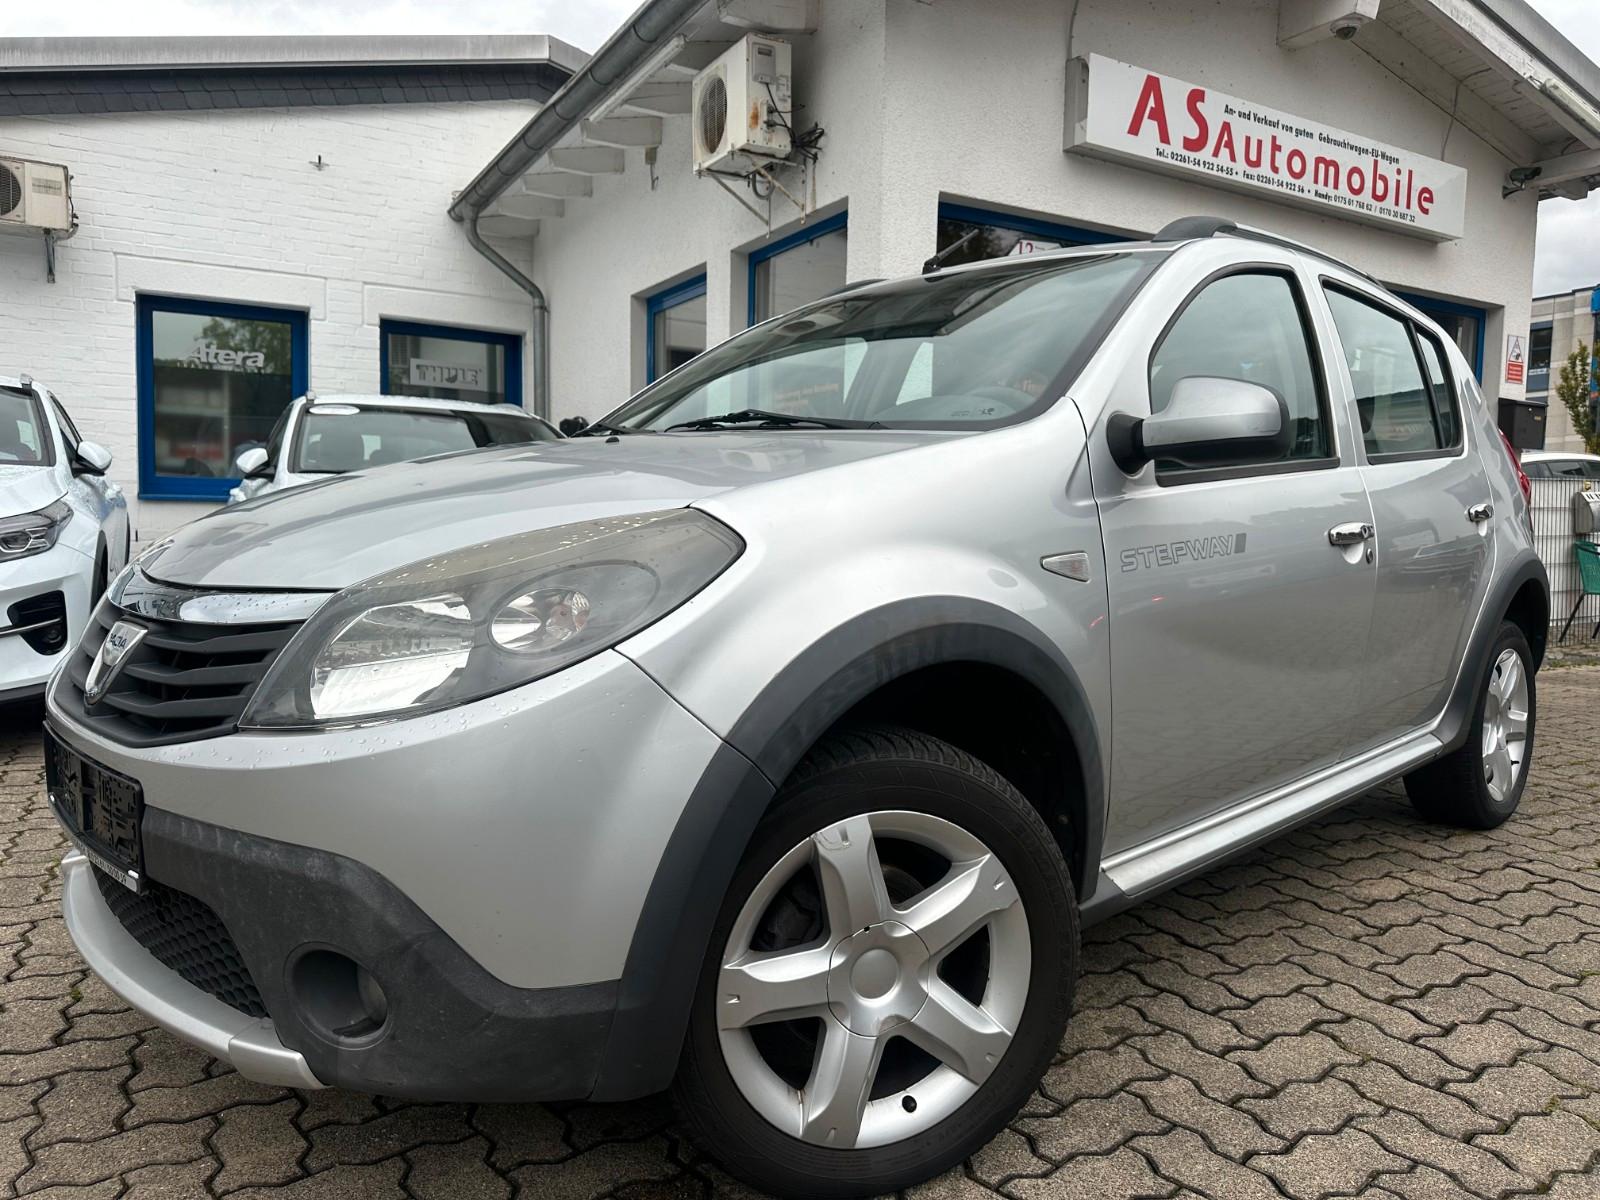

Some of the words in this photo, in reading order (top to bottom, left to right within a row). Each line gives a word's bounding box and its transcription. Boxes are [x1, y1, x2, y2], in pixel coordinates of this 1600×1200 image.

[1224, 104, 1237, 116] An-
[1237, 110, 1251, 121] und
[1252, 112, 1280, 129] Verkauf
[1281, 123, 1293, 133] von
[1294, 127, 1314, 140] guten
[1318, 132, 1400, 165] Gebrauchtwagen-EU-Wagen
[1170, 151, 1201, 168] 02261-54
[1202, 162, 1215, 171] 922
[1216, 165, 1234, 176] 54-55
[1242, 170, 1256, 181] Fax:
[1256, 173, 1284, 189] 02261-54
[1285, 181, 1296, 191] 922
[1314, 189, 1333, 203] Handy:
[1333, 195, 1347, 206] 0175
[1379, 206, 1392, 216] 0170
[1120, 534, 1233, 573] STEPWAY
